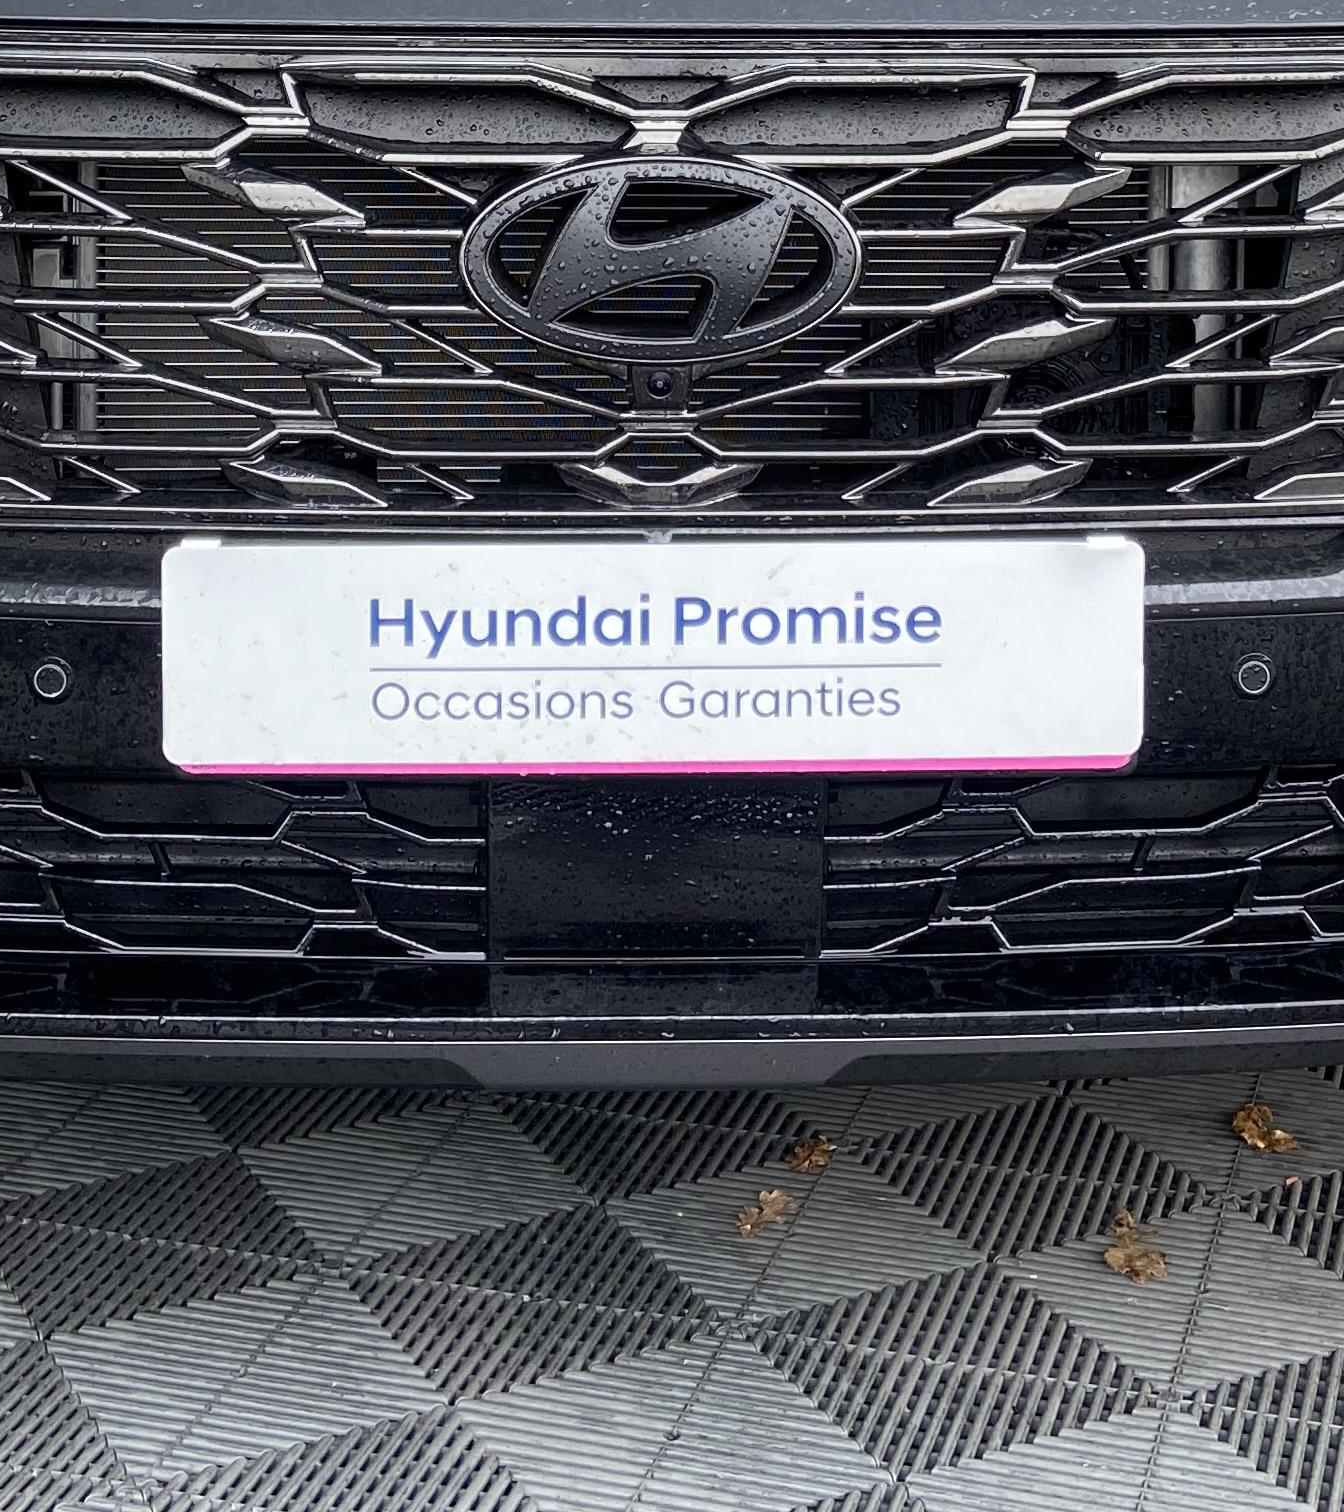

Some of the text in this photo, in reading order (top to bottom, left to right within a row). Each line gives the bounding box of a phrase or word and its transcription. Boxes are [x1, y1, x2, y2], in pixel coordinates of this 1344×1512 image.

[370, 591, 941, 658] Hyundai Promise
[372, 677, 900, 719] Occasions Garanties
